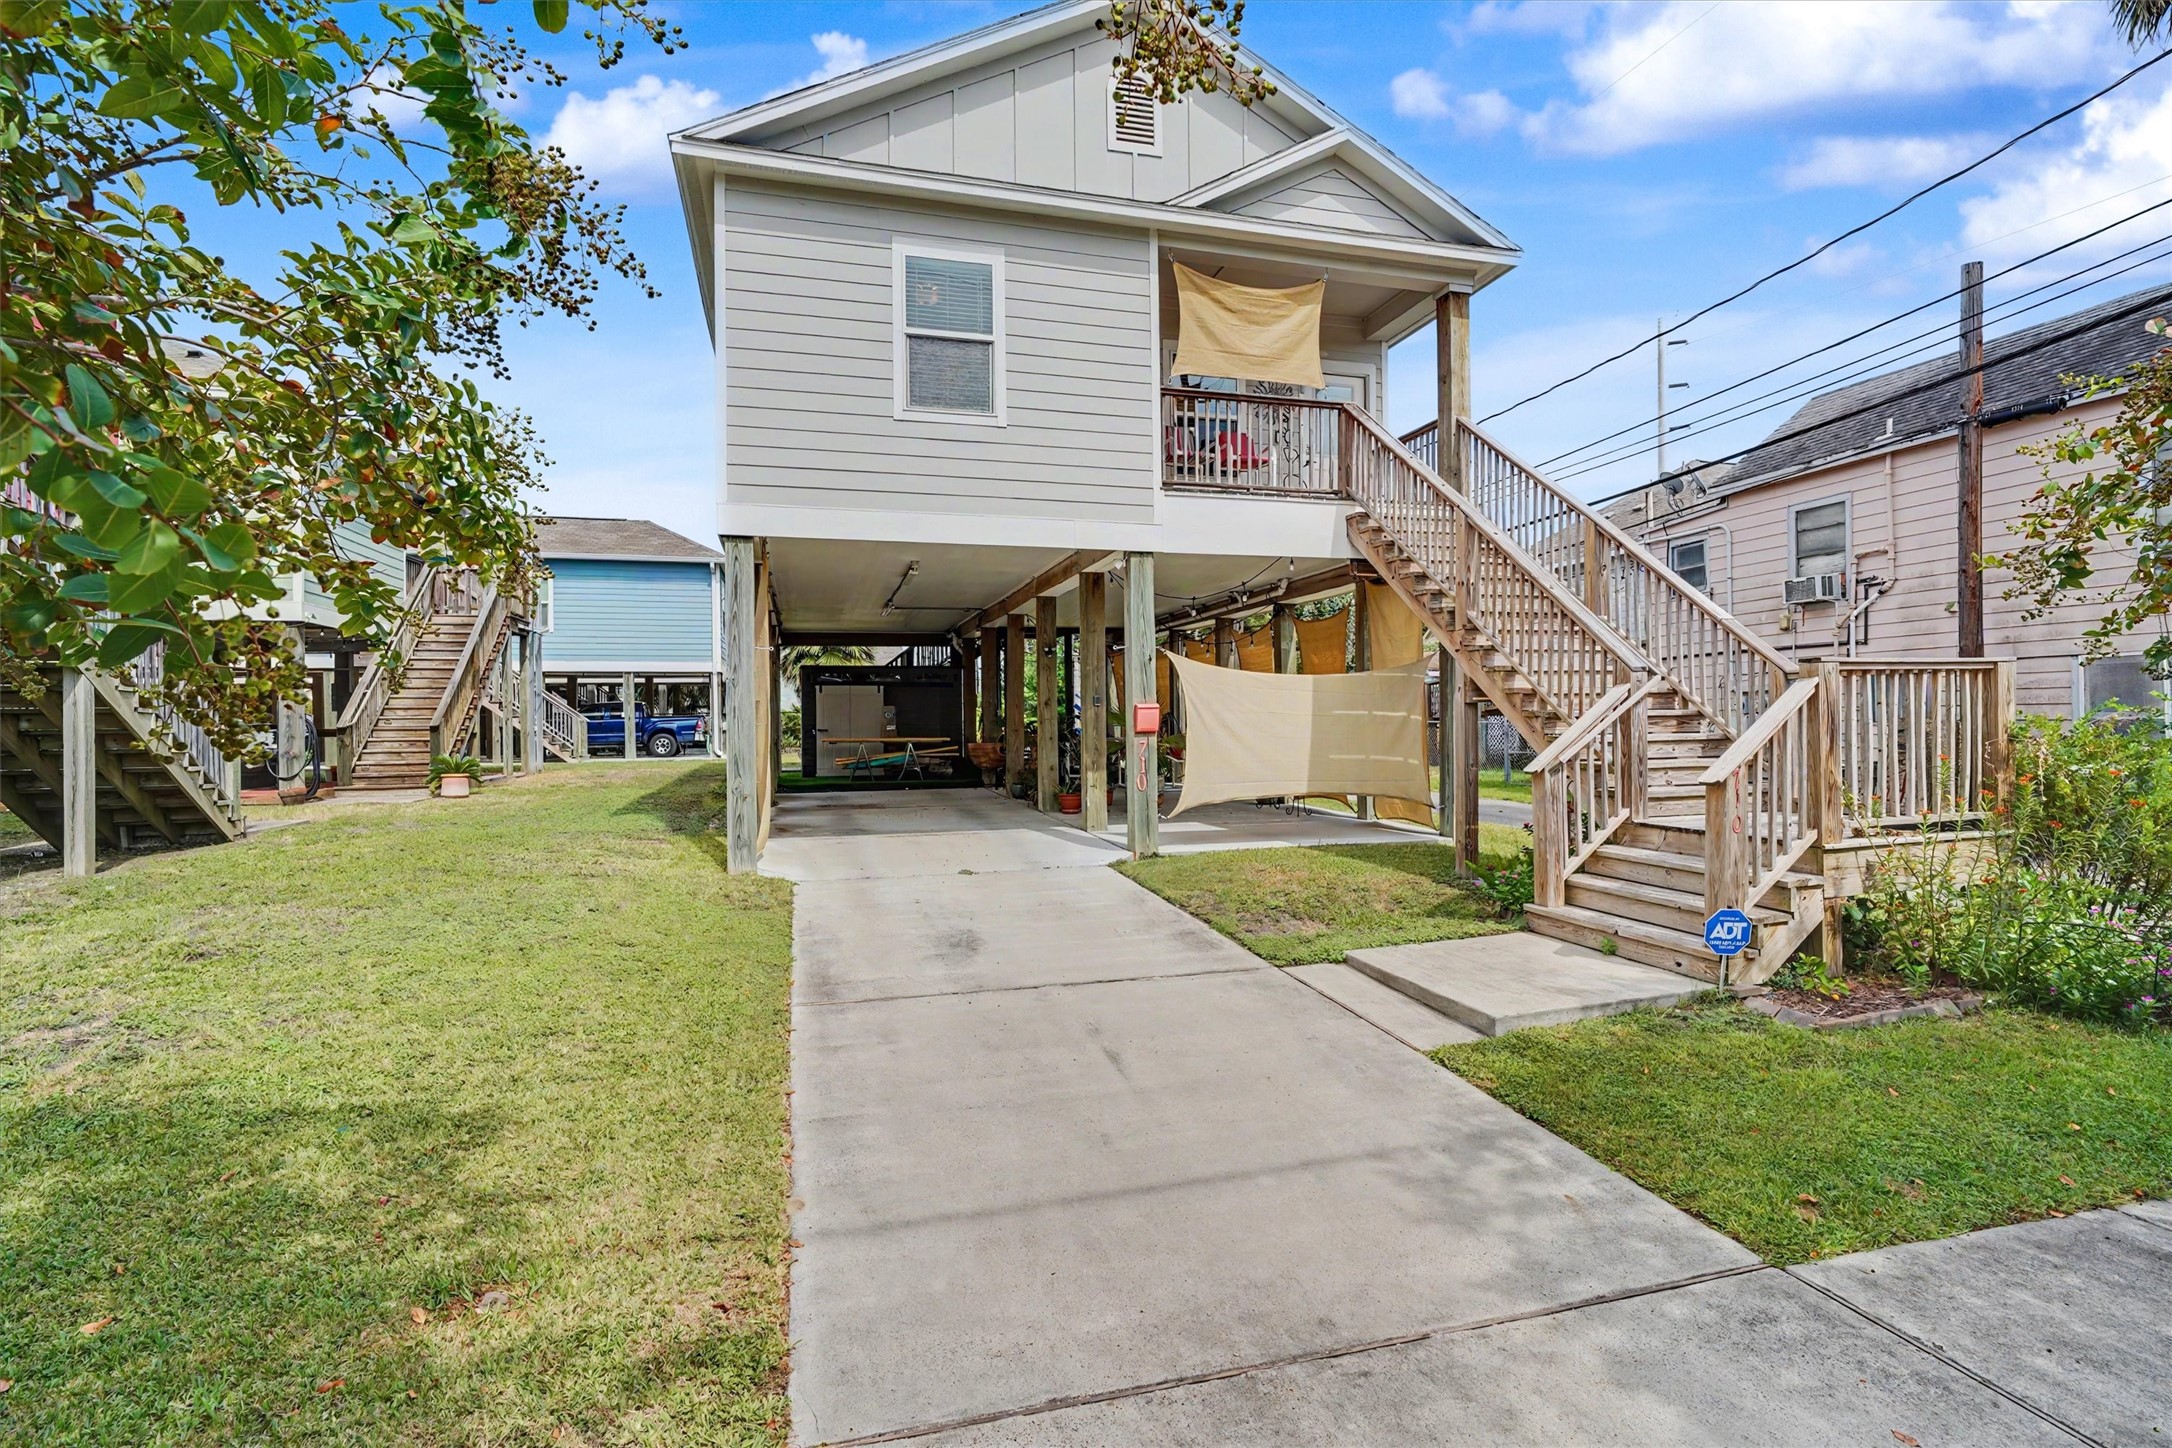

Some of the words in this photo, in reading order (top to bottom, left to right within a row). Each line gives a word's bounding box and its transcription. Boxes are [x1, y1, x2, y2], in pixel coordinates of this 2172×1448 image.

[1136, 740, 1148, 791] 710
[1731, 768, 1742, 833] 710
[1709, 922, 1748, 940] ADT
